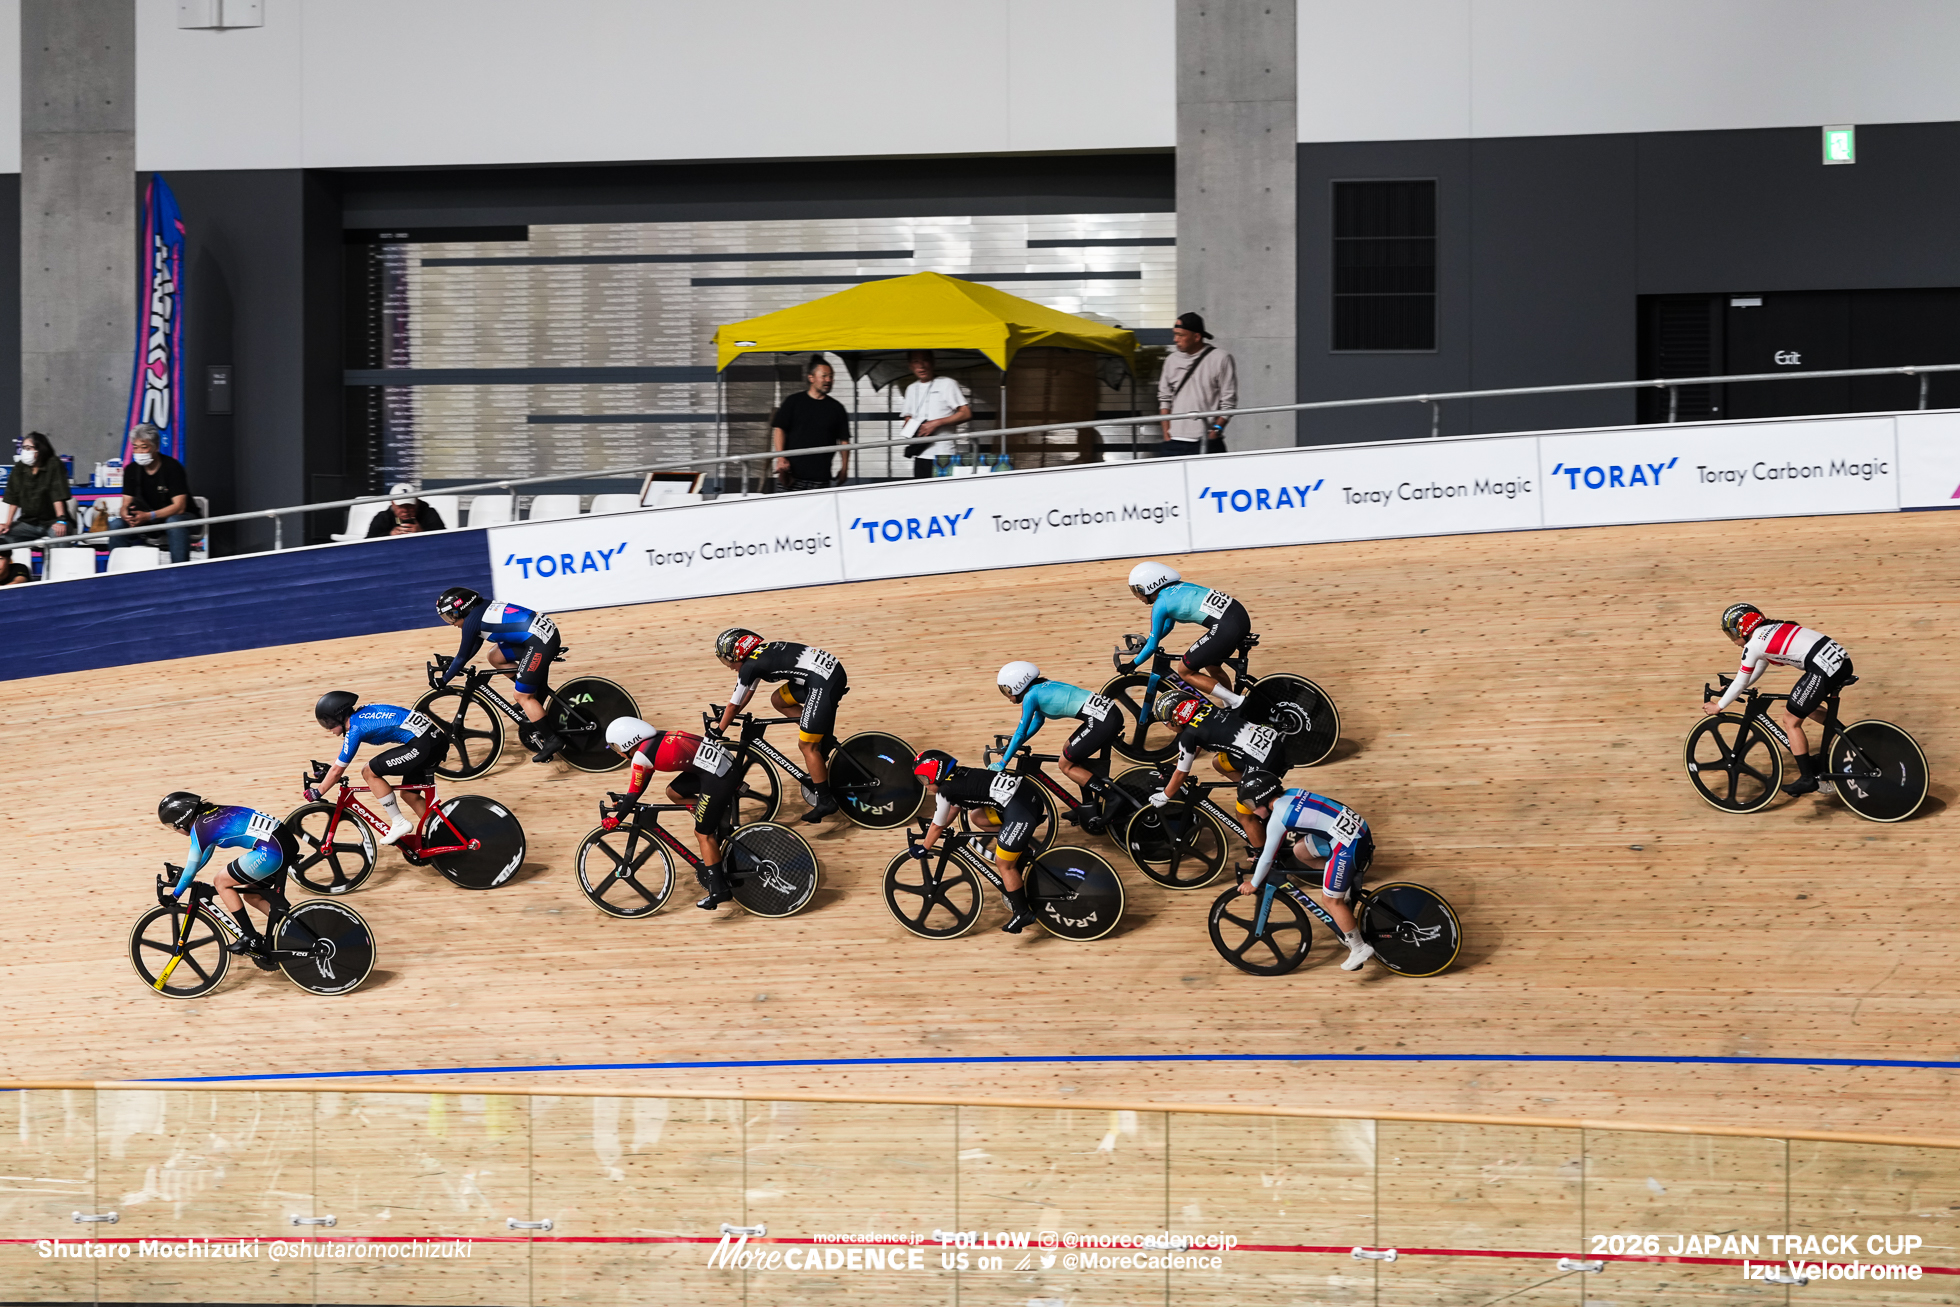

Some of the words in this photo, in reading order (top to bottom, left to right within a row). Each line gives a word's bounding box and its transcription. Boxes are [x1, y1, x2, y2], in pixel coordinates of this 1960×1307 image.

[1774, 350, 1801, 365] Exit
[1697, 465, 1746, 486] Toray
[1753, 460, 1823, 481] Carbon
[1829, 456, 1888, 481] Magic
[1343, 486, 1391, 507] Toray
[1398, 480, 1467, 502] Carbon
[1474, 475, 1531, 500] Magic
[993, 514, 1041, 534] Toray
[1047, 508, 1116, 528] Carbon
[1122, 501, 1179, 524] Magic
[646, 548, 695, 567] Toray
[700, 541, 768, 560] Carbon
[774, 533, 831, 555] Magic
[1147, 576, 1168, 591] KASK
[1206, 593, 1228, 609] 103
[535, 617, 553, 634] 121
[814, 654, 833, 670] 118
[1822, 646, 1844, 665] 117
[1013, 672, 1032, 691] KASK
[479, 684, 523, 722] BRIDGESTONE
[1089, 695, 1110, 711] 104
[408, 713, 429, 729] 107
[1757, 713, 1791, 747] BRIDGES
[622, 734, 642, 749] KASK
[1249, 732, 1271, 750] 127
[700, 746, 718, 762] 101
[753, 738, 804, 779] BRIDGESTONE
[994, 777, 1015, 791] 119
[695, 793, 711, 823] CHINA
[252, 815, 272, 831] 111
[1199, 799, 1249, 840] BRIDGESTONE
[1336, 816, 1357, 836] 123
[653, 827, 687, 857] ARGON
[957, 846, 1002, 887] BRIDGESTONE
[1279, 881, 1333, 924] FACTOR
[200, 897, 244, 937] LOOK
